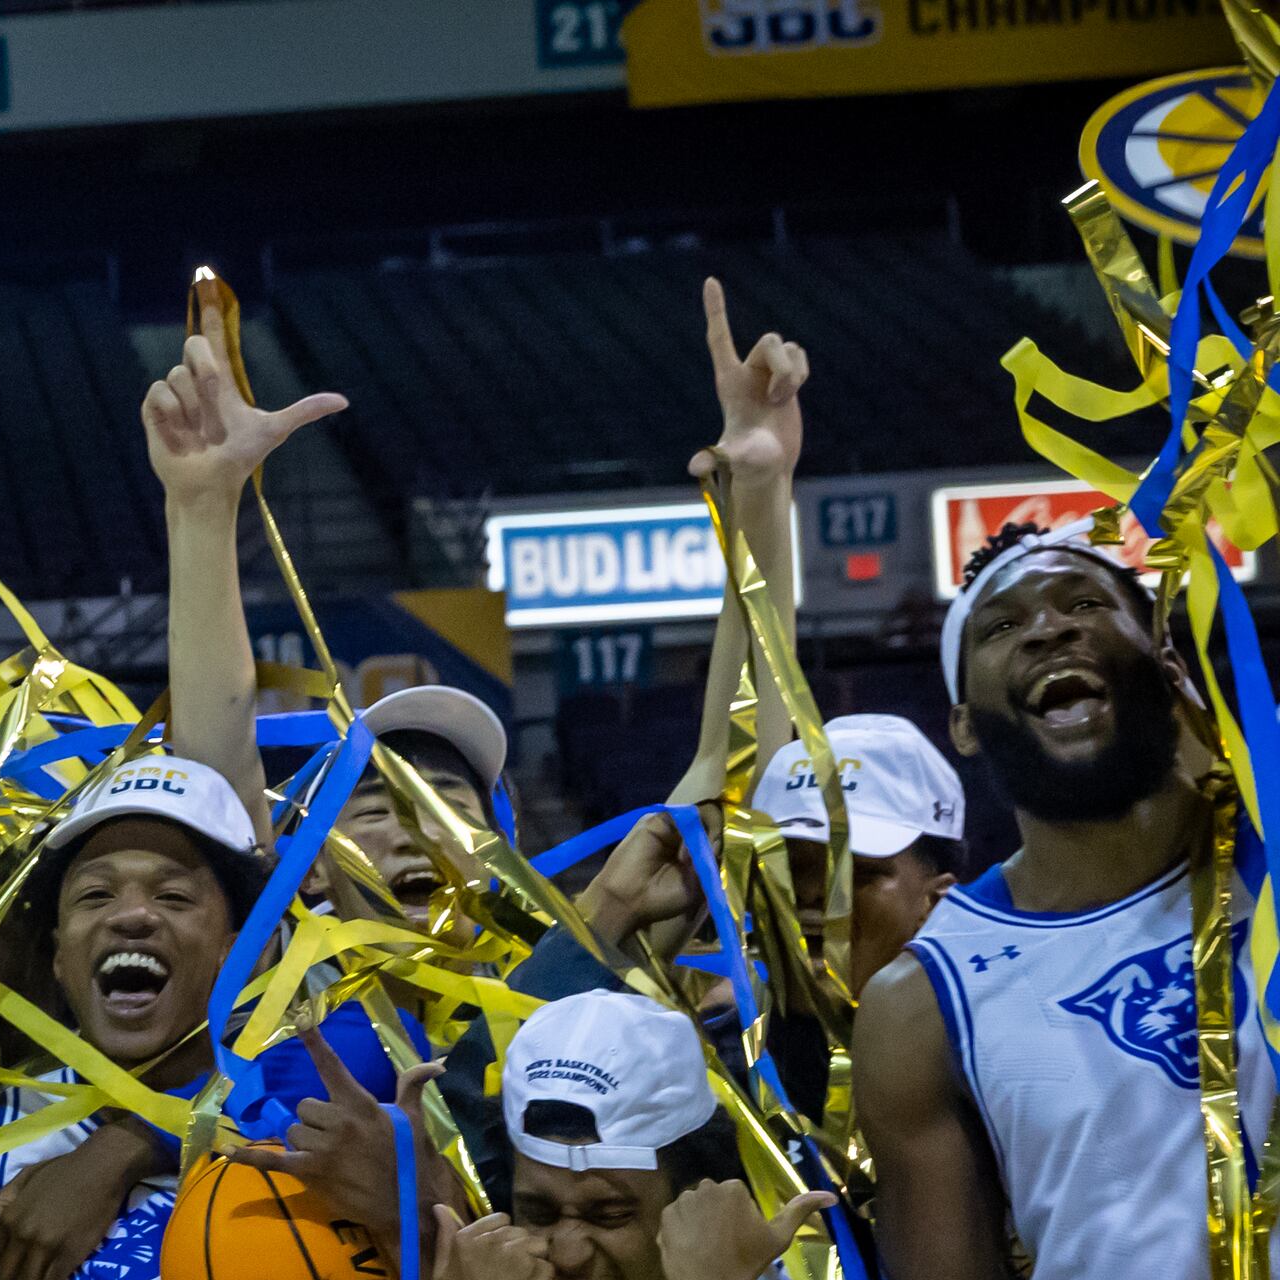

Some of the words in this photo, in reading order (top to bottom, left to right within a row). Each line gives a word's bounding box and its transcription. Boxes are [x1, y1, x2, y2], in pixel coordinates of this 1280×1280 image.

[550, 5, 610, 52] 21
[511, 531, 621, 598] BUD
[571, 634, 643, 684] 117
[110, 766, 186, 796] SBC
[556, 1059, 619, 1090] BASKETBALL
